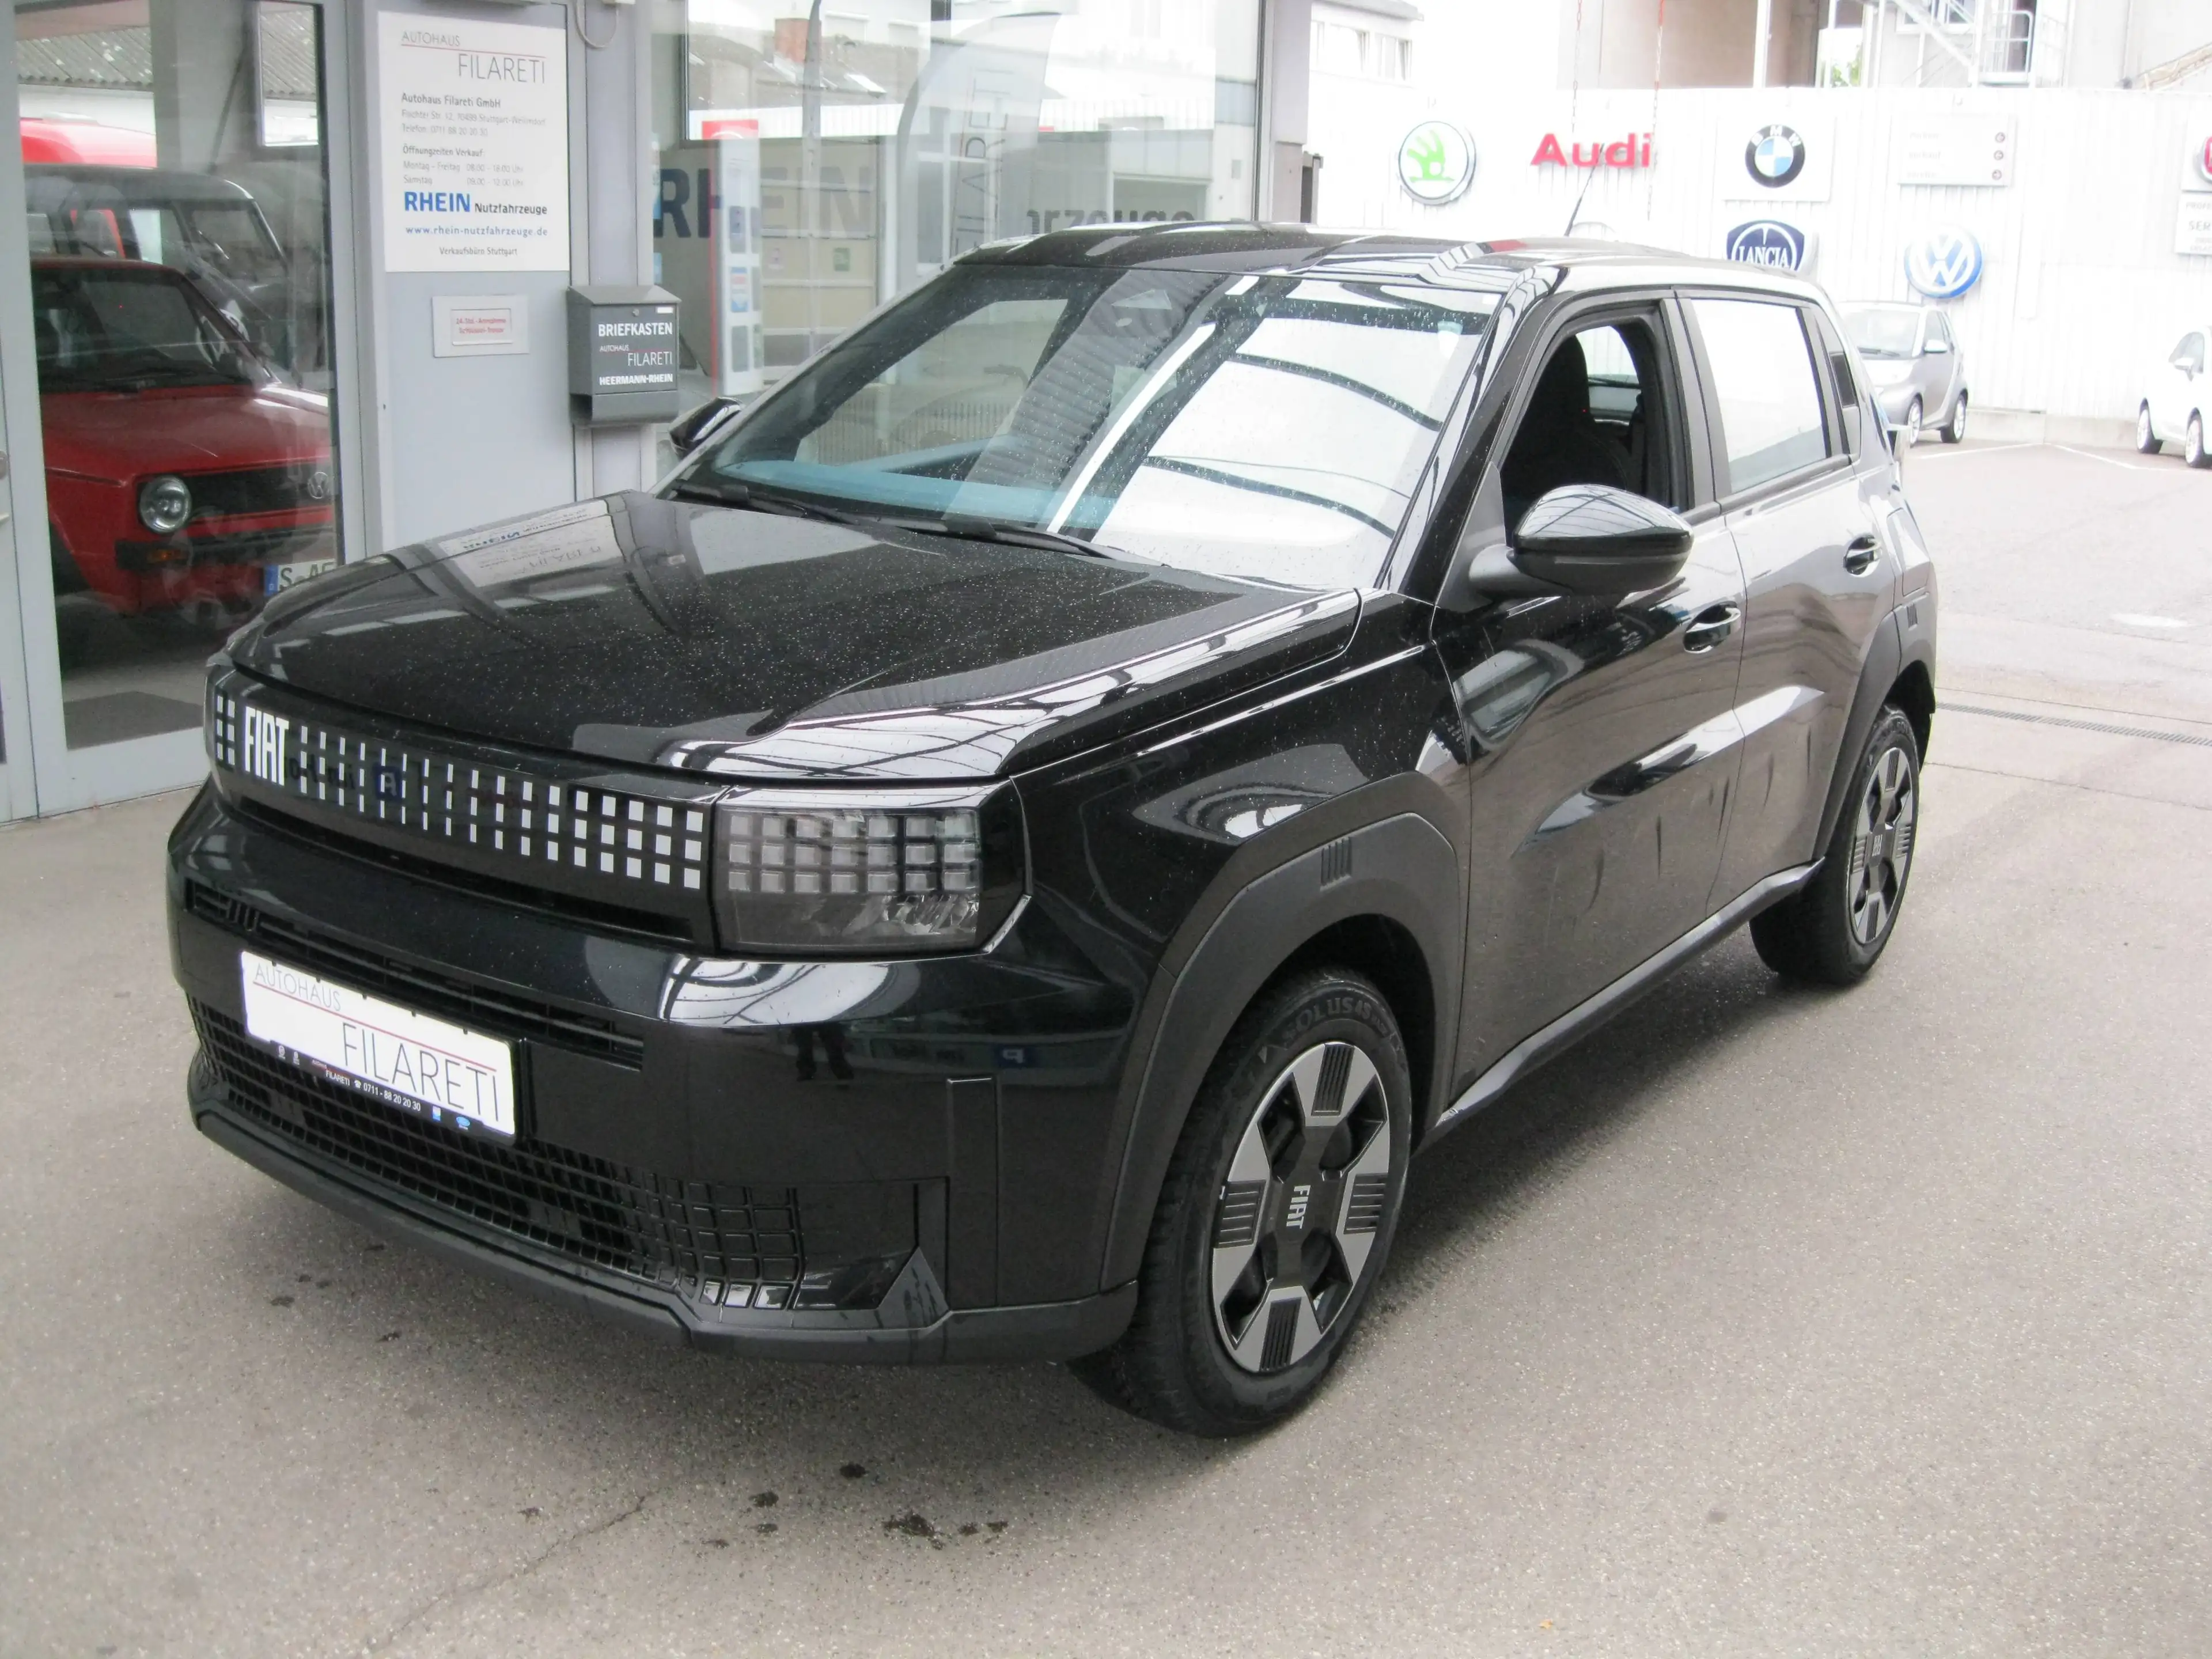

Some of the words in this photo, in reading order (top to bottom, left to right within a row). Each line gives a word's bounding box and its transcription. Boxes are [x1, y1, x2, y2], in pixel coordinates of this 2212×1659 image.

[402, 31, 460, 47] AUTOHAUS
[458, 53, 546, 84] FILARETI
[402, 93, 442, 106] Autohaus
[444, 95, 474, 108] Filareti
[476, 97, 501, 109] GmbH
[1530, 132, 1653, 169] Audi
[404, 191, 471, 213] RHEIN
[475, 202, 548, 216] Nutzfahrzeuge
[406, 225, 548, 237] www.rhein-nutzfahrzeuge.de
[487, 247, 518, 257] Stuttgart
[1738, 245, 1790, 269] LANCIA
[598, 322, 673, 337] BRIEFKASTEN
[600, 344, 630, 353] AUTOHAUS
[627, 351, 673, 366] FILARETI
[599, 373, 673, 385] HEERMANN-RHEIN
[244, 705, 290, 787] FIAT
[255, 963, 342, 1012] AUTOHAUS
[342, 1021, 499, 1122] FILARETI
[325, 1069, 350, 1086] FILARETI
[363, 1083, 379, 1096] 0711
[393, 1093, 402, 1104] 20
[403, 1097, 411, 1108] 20
[412, 1101, 421, 1112] 30
[1285, 1184, 1311, 1229] FIAT
